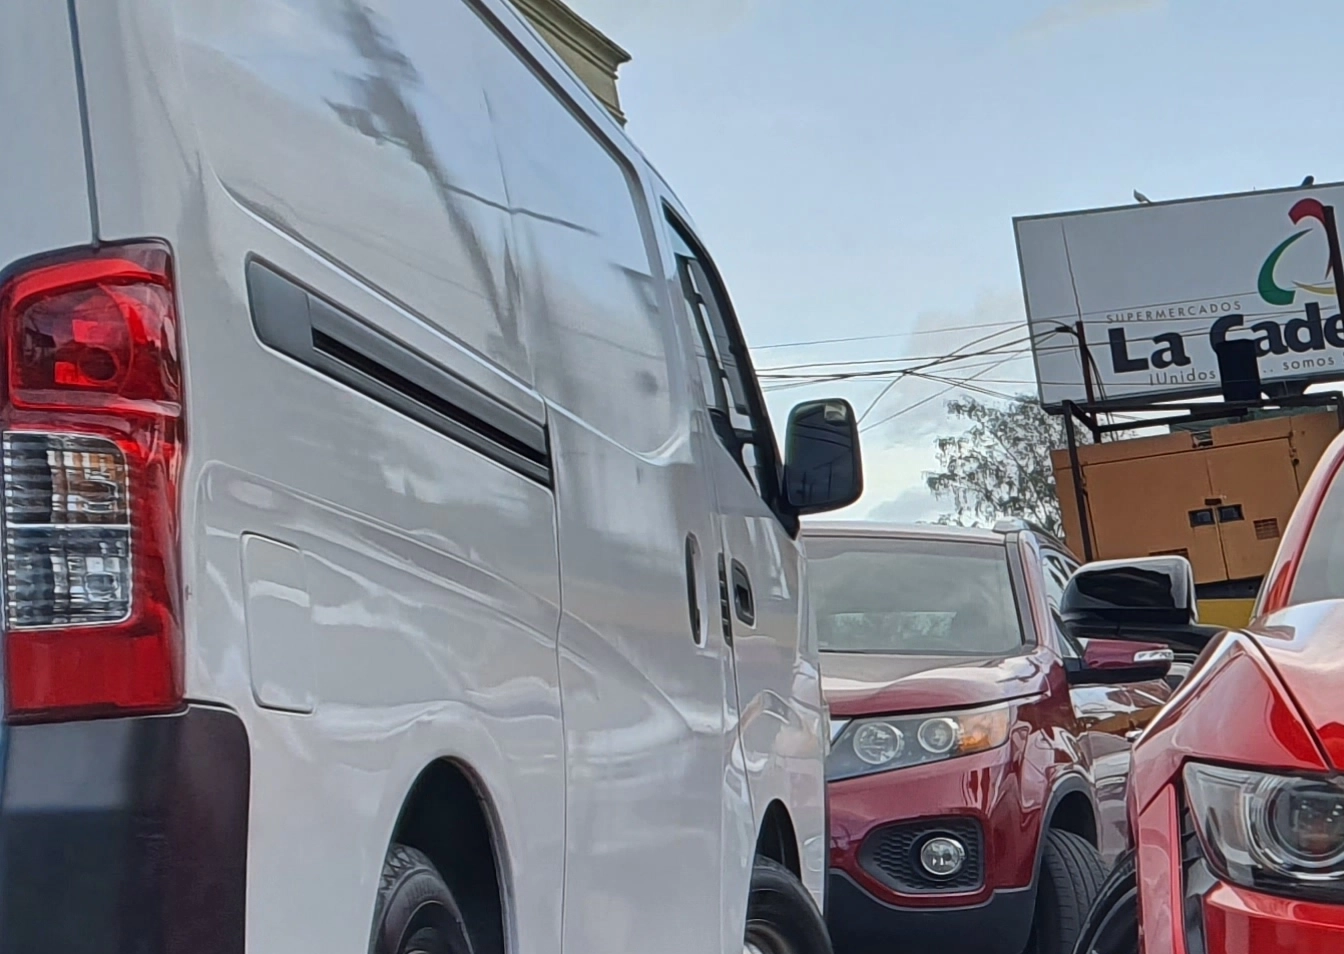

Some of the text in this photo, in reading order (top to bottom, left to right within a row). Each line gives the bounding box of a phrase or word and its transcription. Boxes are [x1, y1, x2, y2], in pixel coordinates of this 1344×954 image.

[1106, 301, 1242, 324] SUPERMERCADOS
[1108, 327, 1191, 373] La
[1283, 355, 1335, 371] somos
